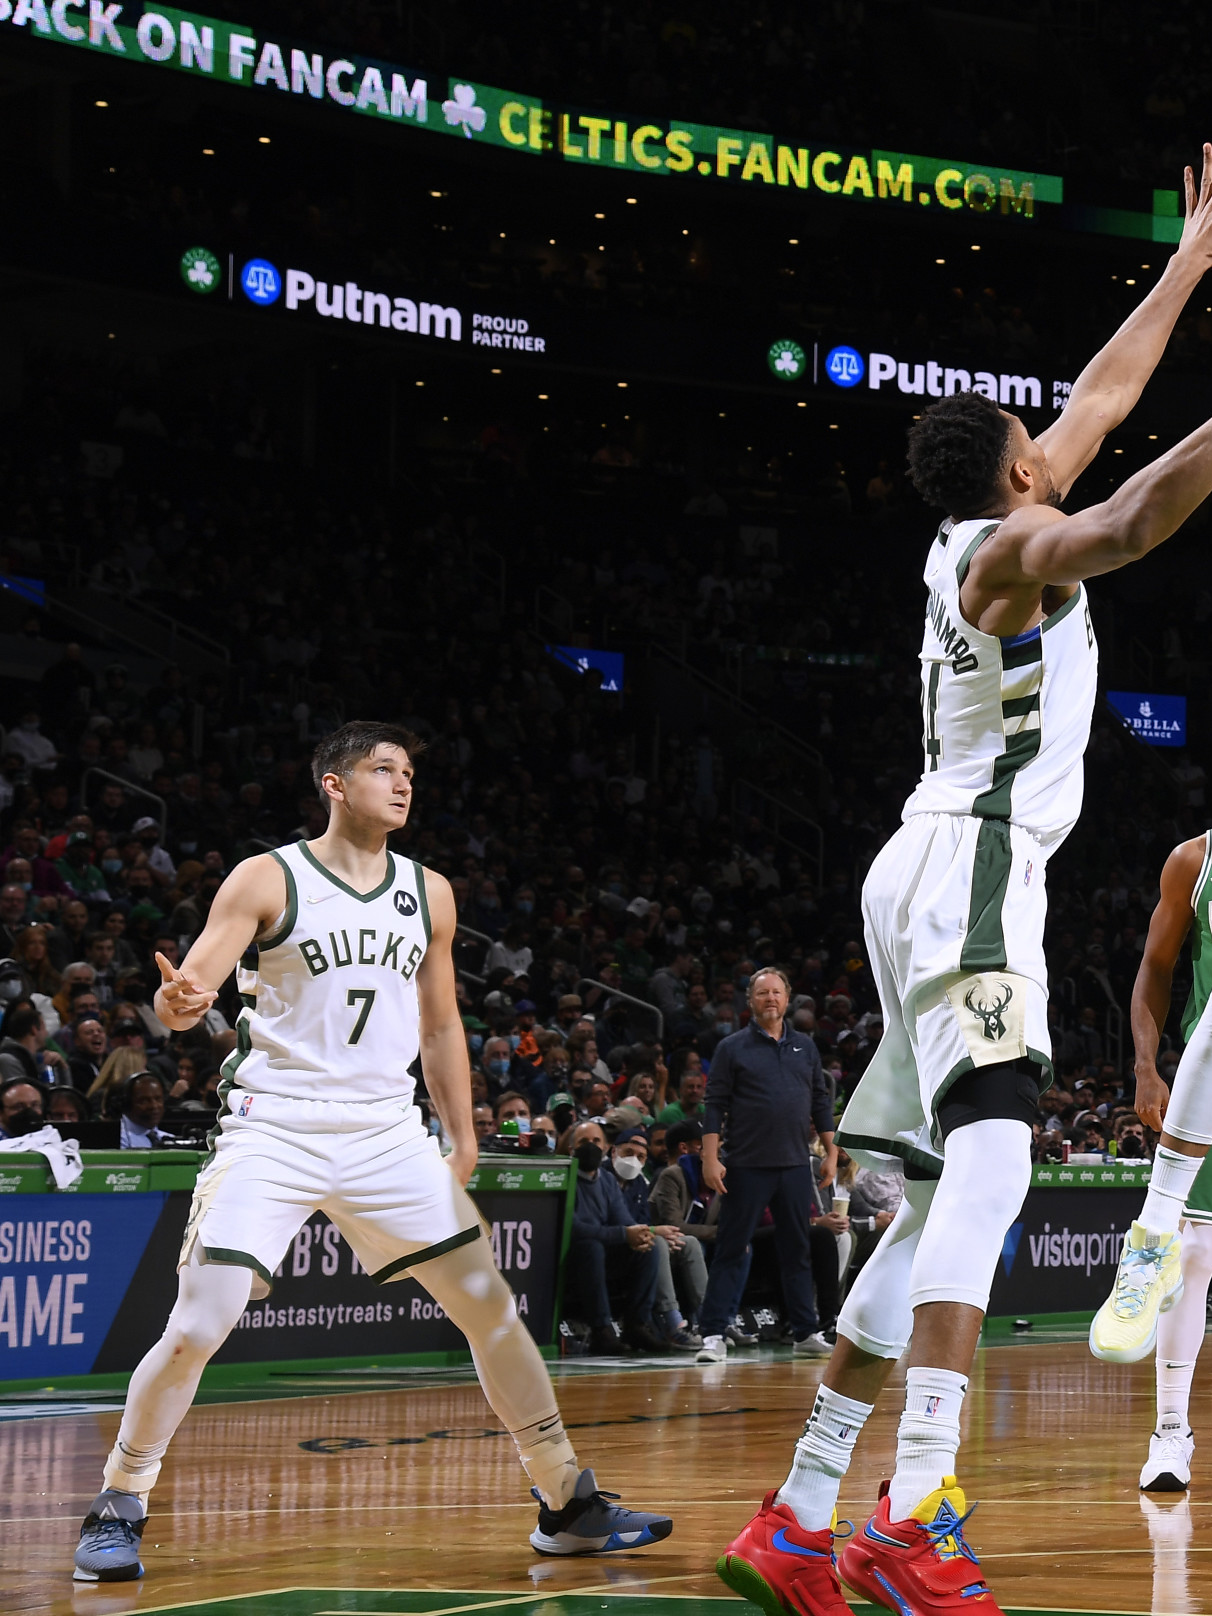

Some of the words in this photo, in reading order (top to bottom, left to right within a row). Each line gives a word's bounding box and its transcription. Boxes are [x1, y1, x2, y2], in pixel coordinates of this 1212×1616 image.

[137, 13, 214, 72] ON
[229, 33, 428, 122] FANCAM
[499, 101, 1034, 218] CELTICS.FANCAM.COM
[286, 268, 462, 342] Putnam
[472, 313, 529, 334] PROUD
[472, 329, 546, 353] PARTNER
[868, 352, 1042, 408] Putnam
[297, 928, 423, 982] BUCKS
[345, 987, 377, 1048] 7
[0, 1219, 92, 1264] SINESS
[274, 1223, 341, 1277] B'S
[0, 1273, 89, 1348] AME
[234, 1300, 393, 1330] nabstastytreats
